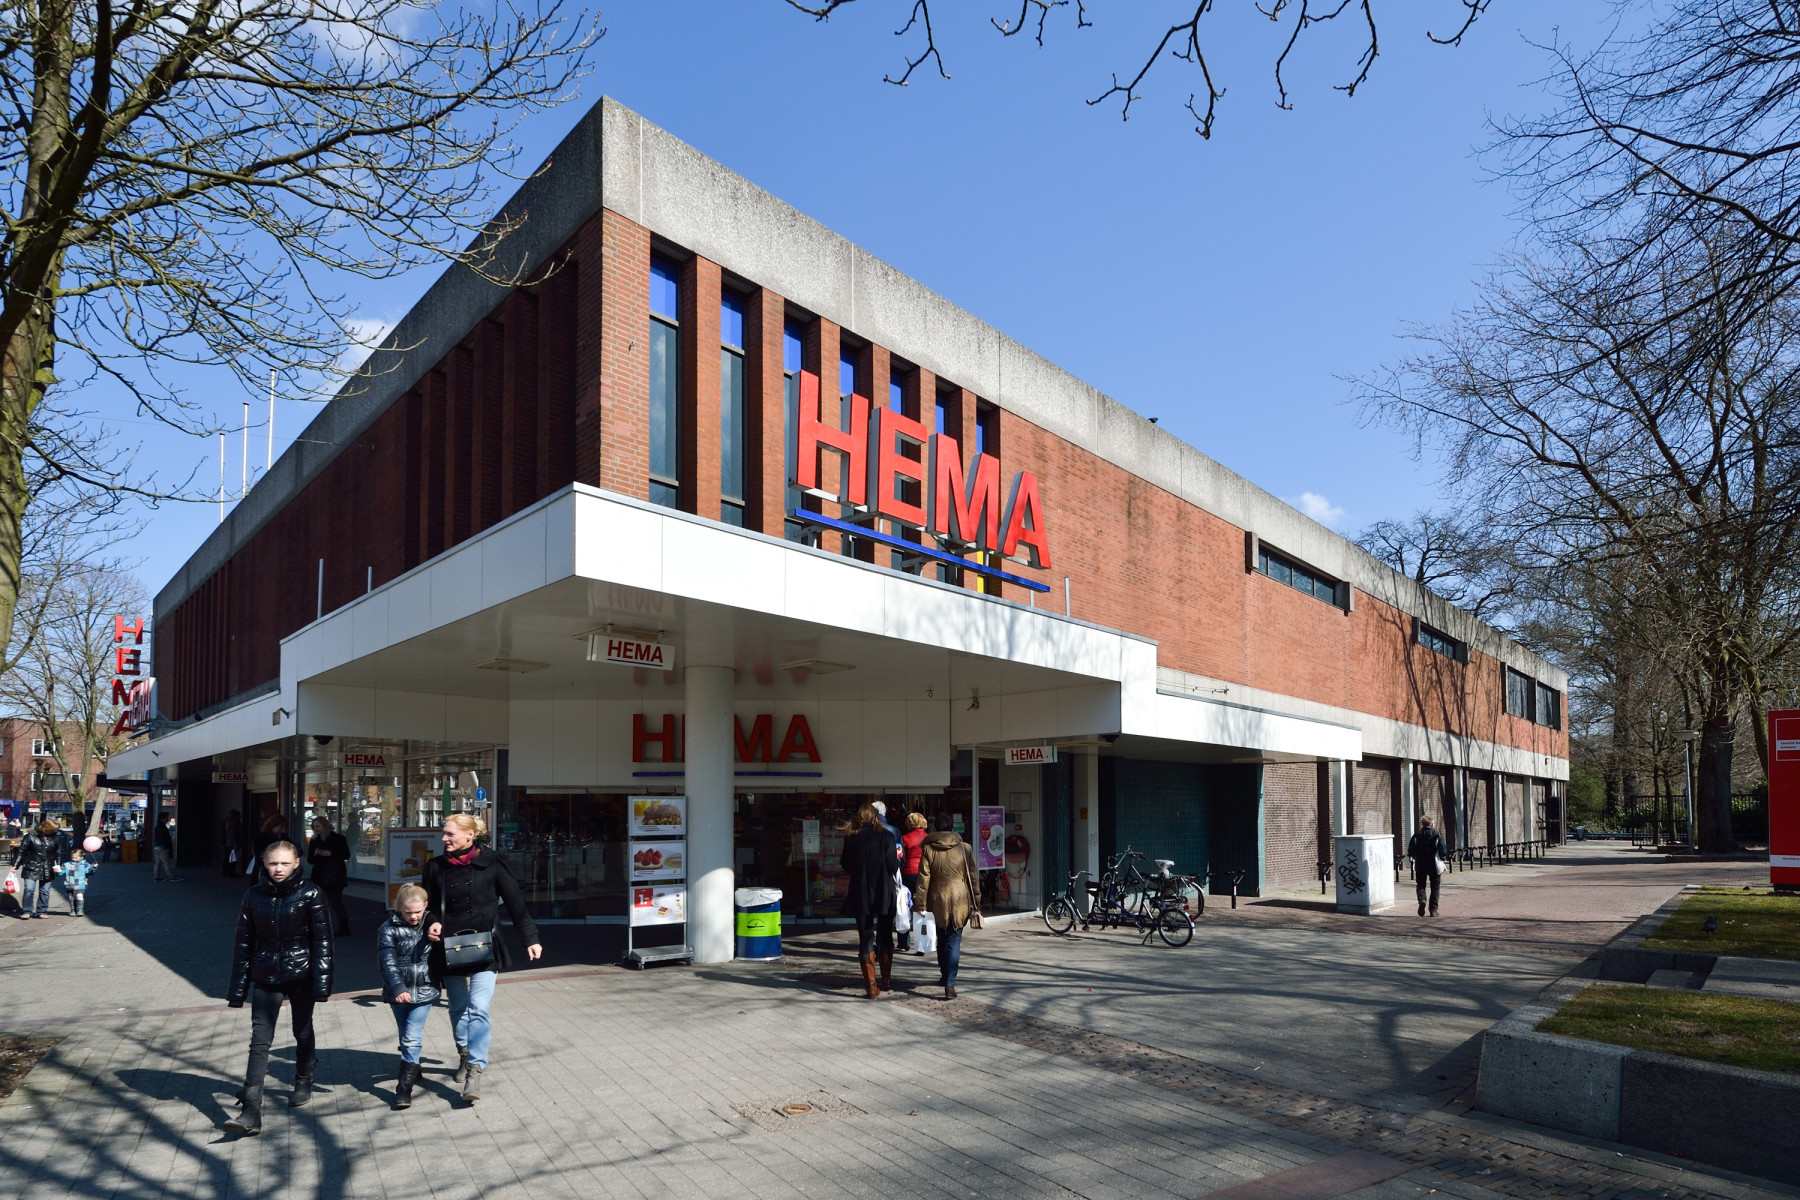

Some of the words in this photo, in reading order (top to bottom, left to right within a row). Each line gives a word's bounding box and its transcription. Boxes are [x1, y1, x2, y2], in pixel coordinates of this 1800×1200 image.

[788, 369, 1051, 569] HEMA
[607, 639, 664, 663] HEMA
[632, 713, 822, 763] HMA
[344, 753, 386, 766] HEMA
[1010, 747, 1044, 761] HEMA
[219, 772, 249, 781] HEMA
